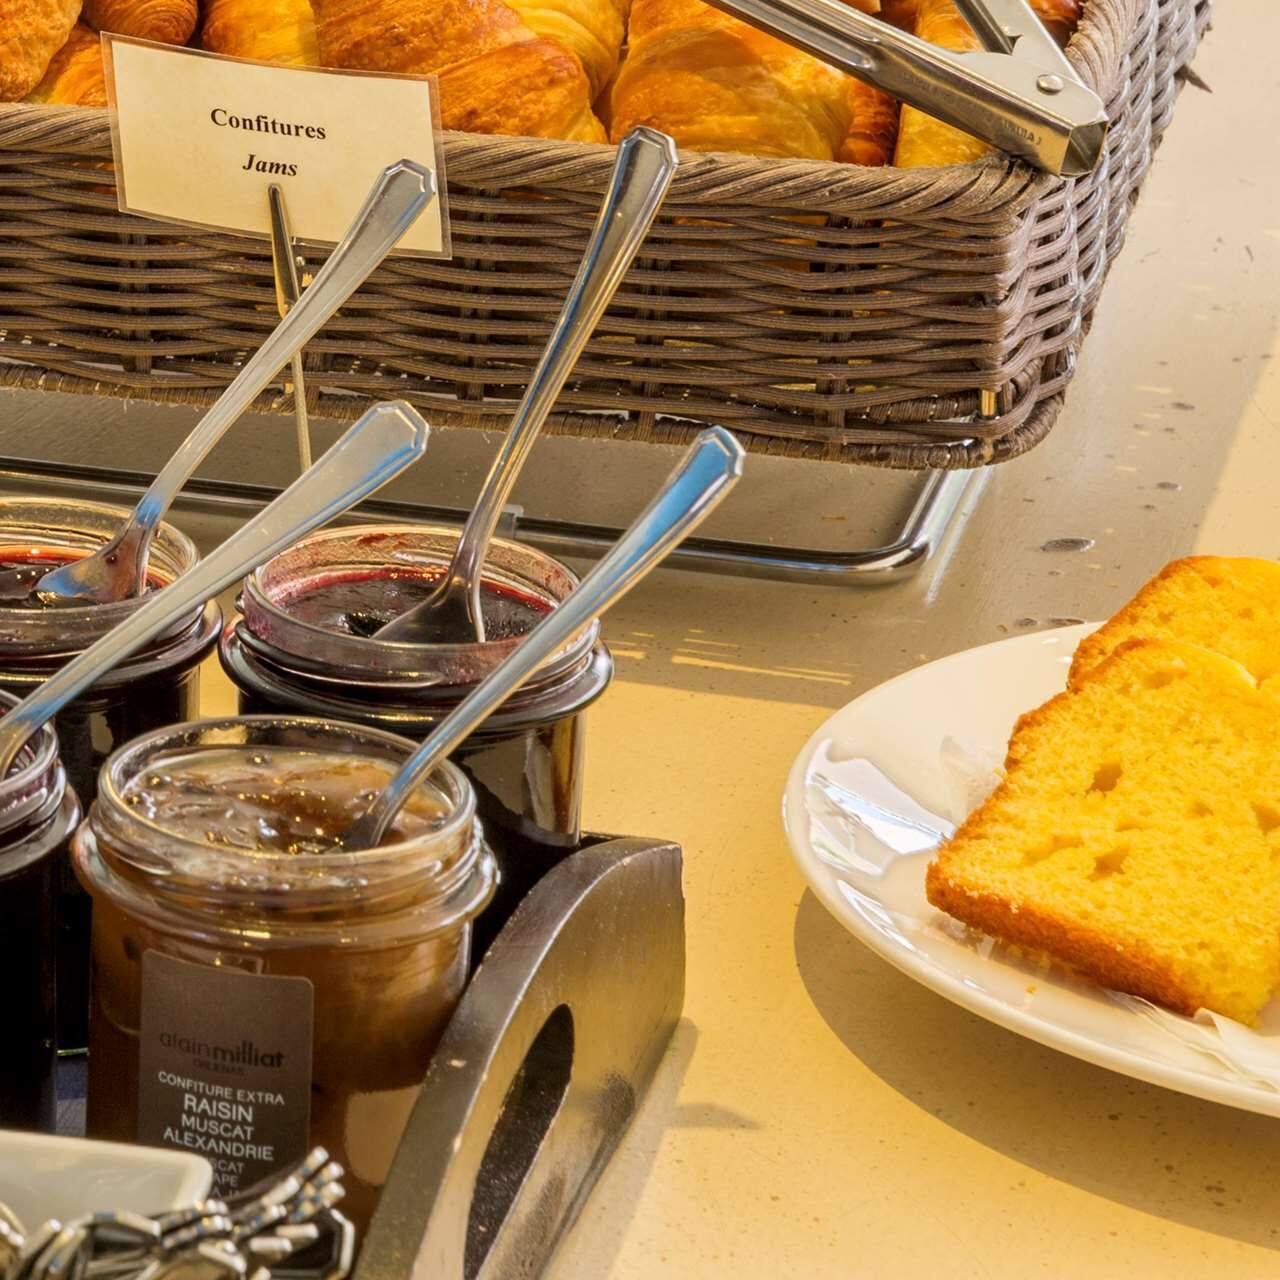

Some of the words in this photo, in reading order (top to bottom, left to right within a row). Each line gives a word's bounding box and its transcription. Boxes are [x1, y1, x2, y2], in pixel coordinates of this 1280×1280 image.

[210, 107, 327, 141] Confitures
[242, 153, 299, 178] Jams
[159, 1030, 285, 1069] alainmilliat
[157, 1070, 233, 1100] CONFITURE
[236, 1087, 286, 1106] EXTRA
[183, 1092, 254, 1122] RAISIN
[163, 1126, 275, 1161] ALEXANDRIE
[181, 1113, 255, 1141] MUSCAT
